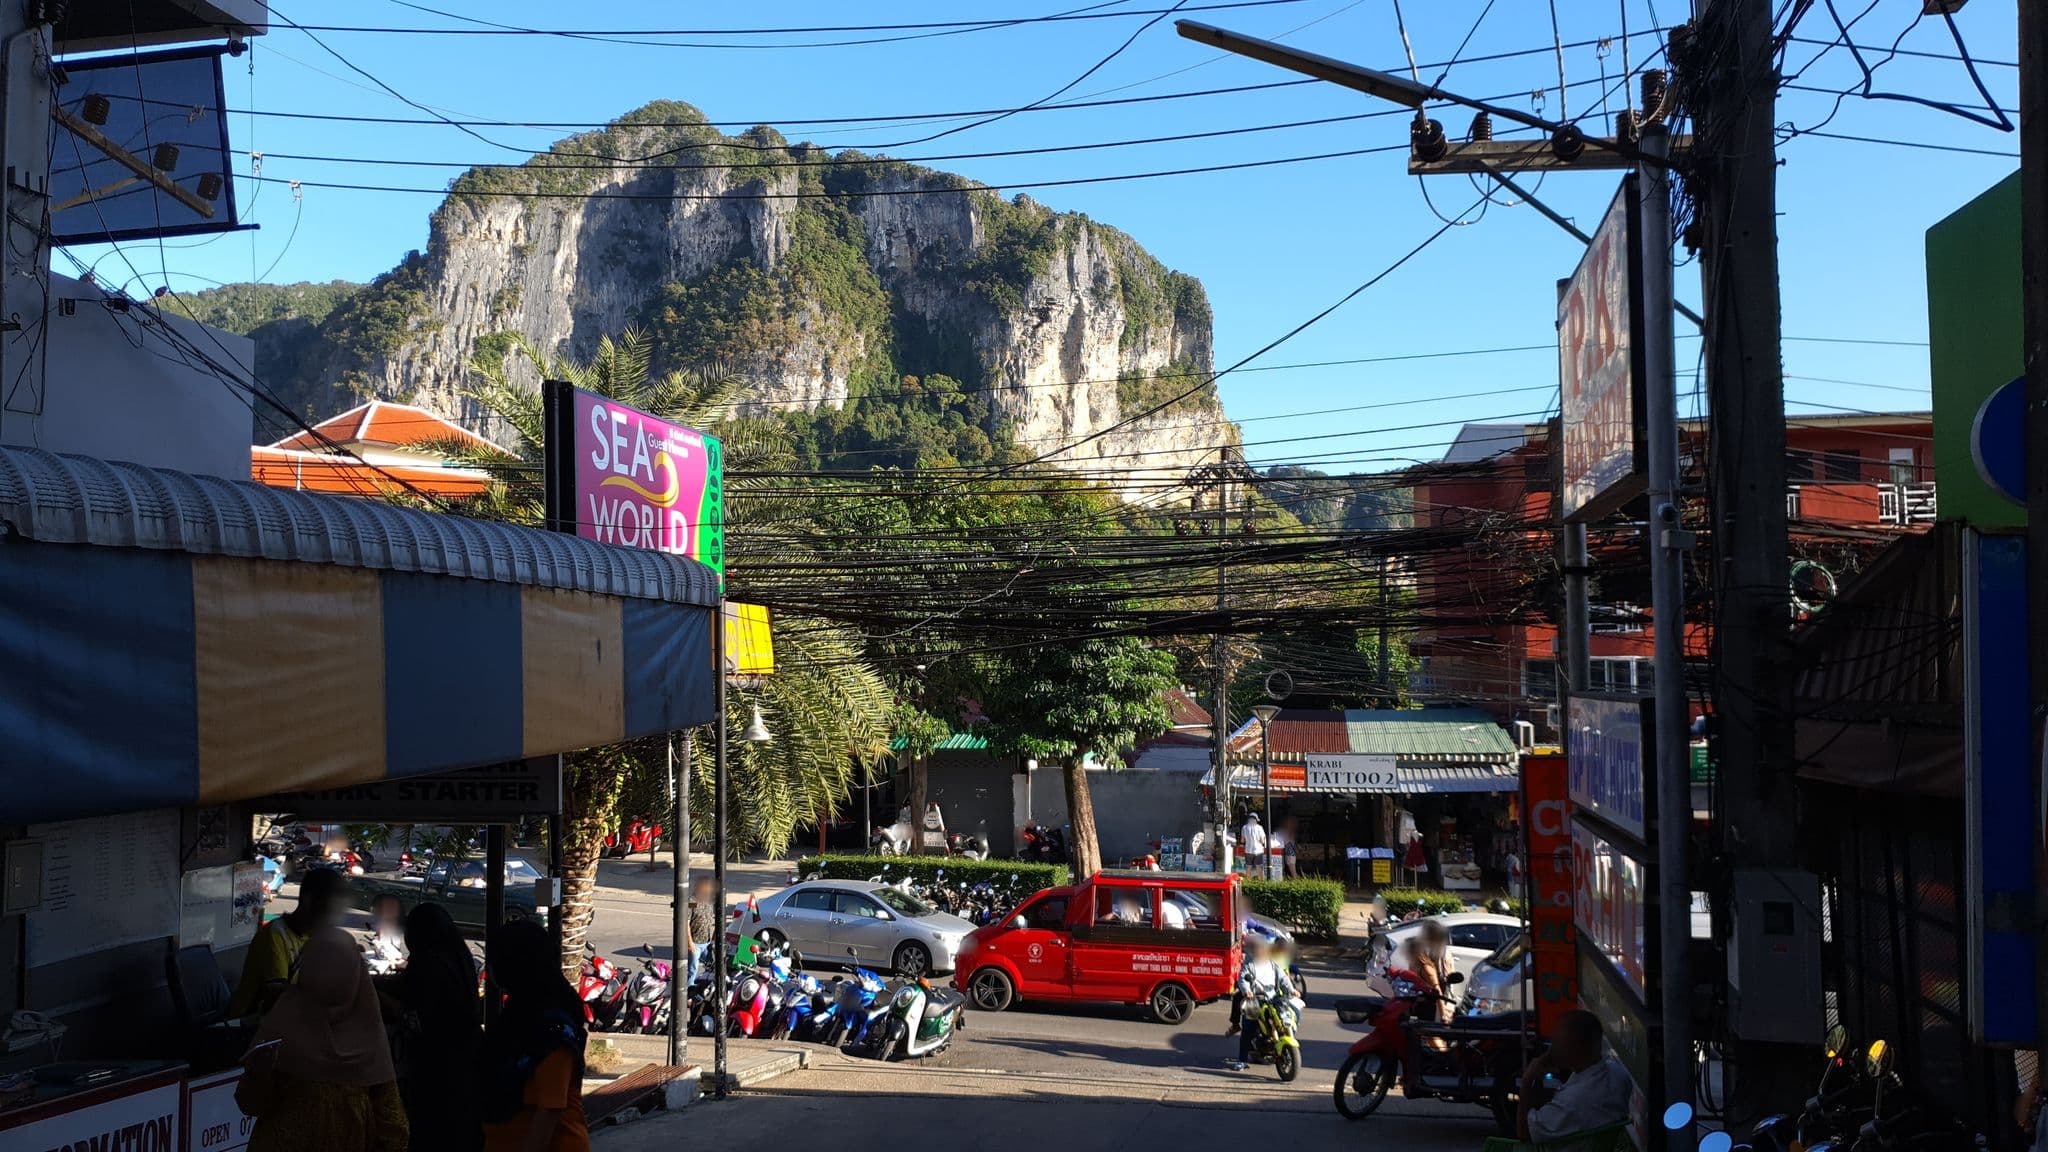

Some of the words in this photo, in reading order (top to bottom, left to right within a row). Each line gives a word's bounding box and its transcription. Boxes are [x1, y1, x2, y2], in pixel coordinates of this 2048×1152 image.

[591, 404, 654, 482] SEA
[589, 493, 688, 555] WORLD
[1309, 760, 1342, 769] KRABI
[1309, 772, 1381, 785] TATTOO
[1385, 773, 1394, 785] 2
[399, 782, 538, 801] STARTER
[201, 1122, 231, 1148] OPEN
